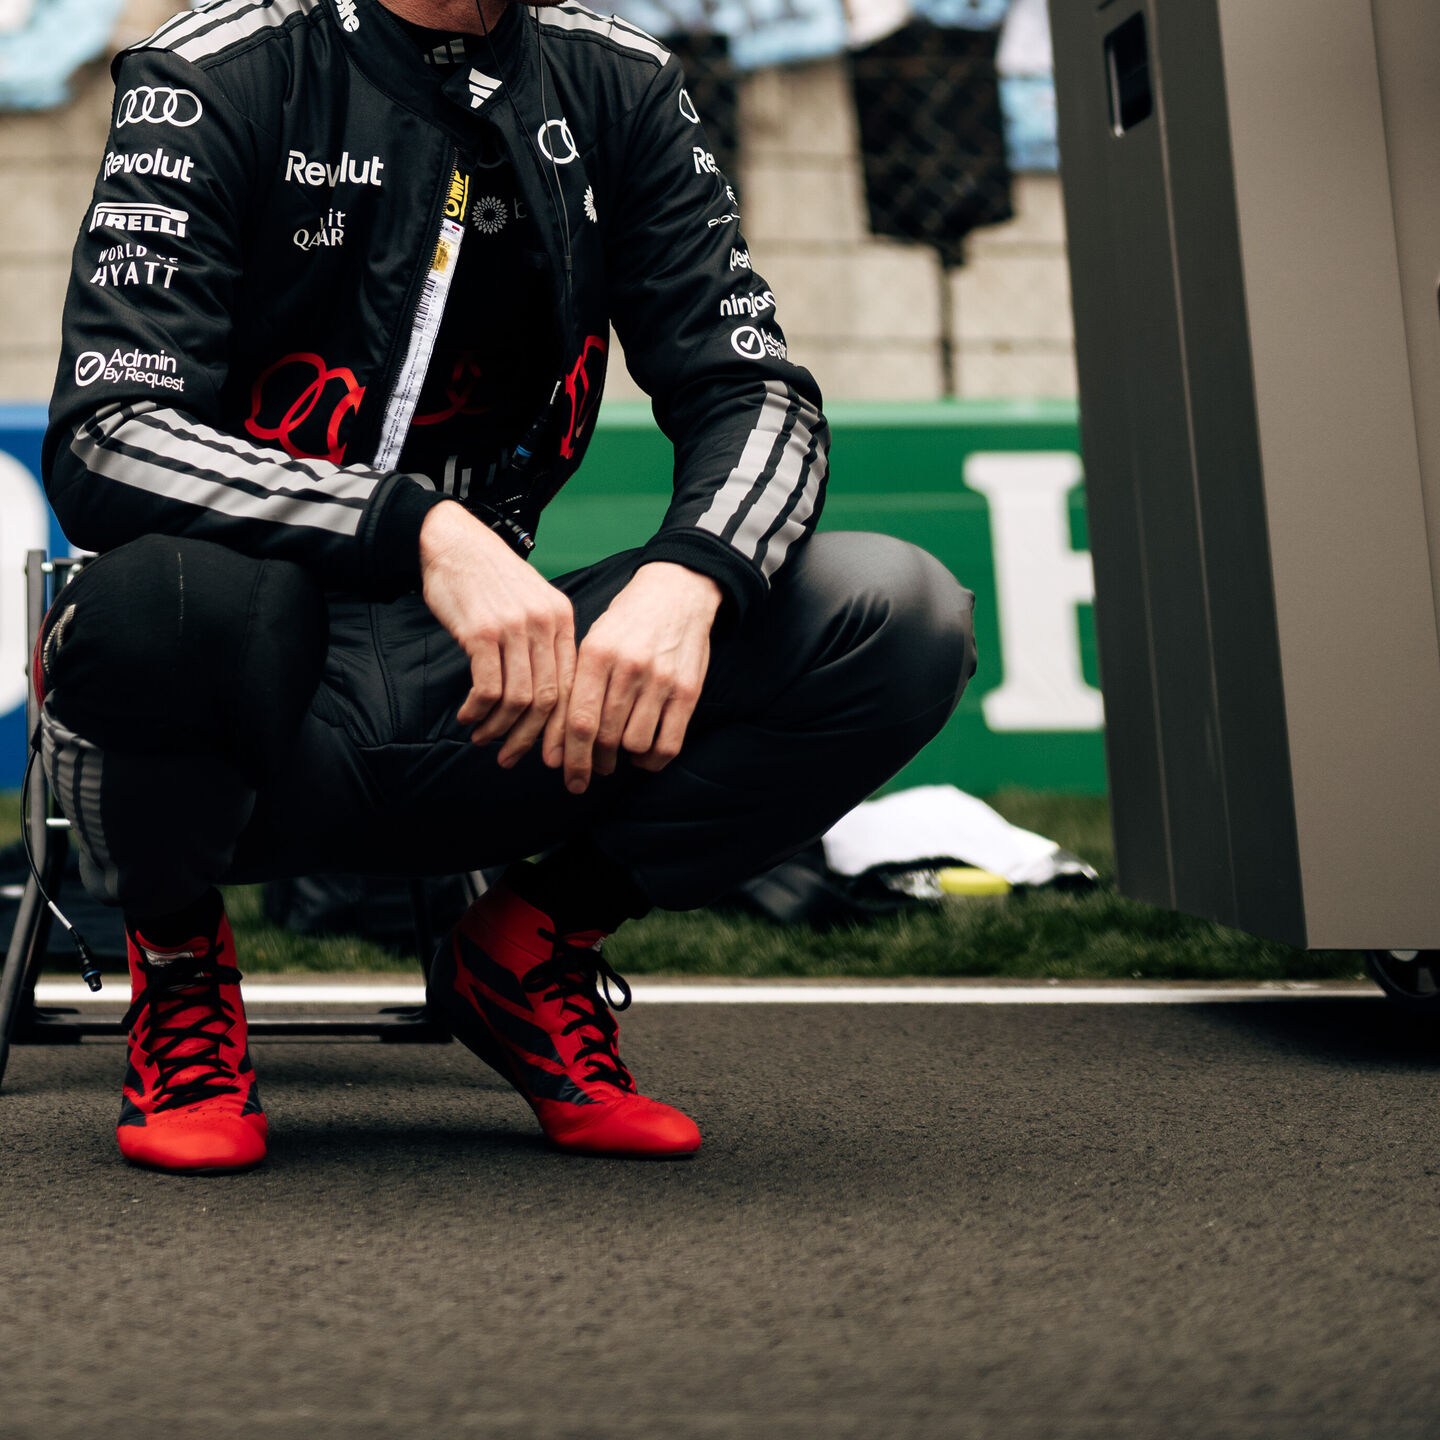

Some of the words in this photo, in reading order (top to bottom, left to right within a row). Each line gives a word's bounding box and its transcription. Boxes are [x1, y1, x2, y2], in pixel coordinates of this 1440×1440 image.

[103, 147, 194, 183] Revolut
[284, 149, 384, 187] Revlut
[445, 169, 465, 217] OMP
[98, 242, 148, 263] WORLD
[293, 227, 345, 251] QAAR
[89, 261, 179, 289] HYATT
[106, 348, 177, 374] Admin
[103, 367, 124, 383] By
[125, 368, 185, 392] Request
